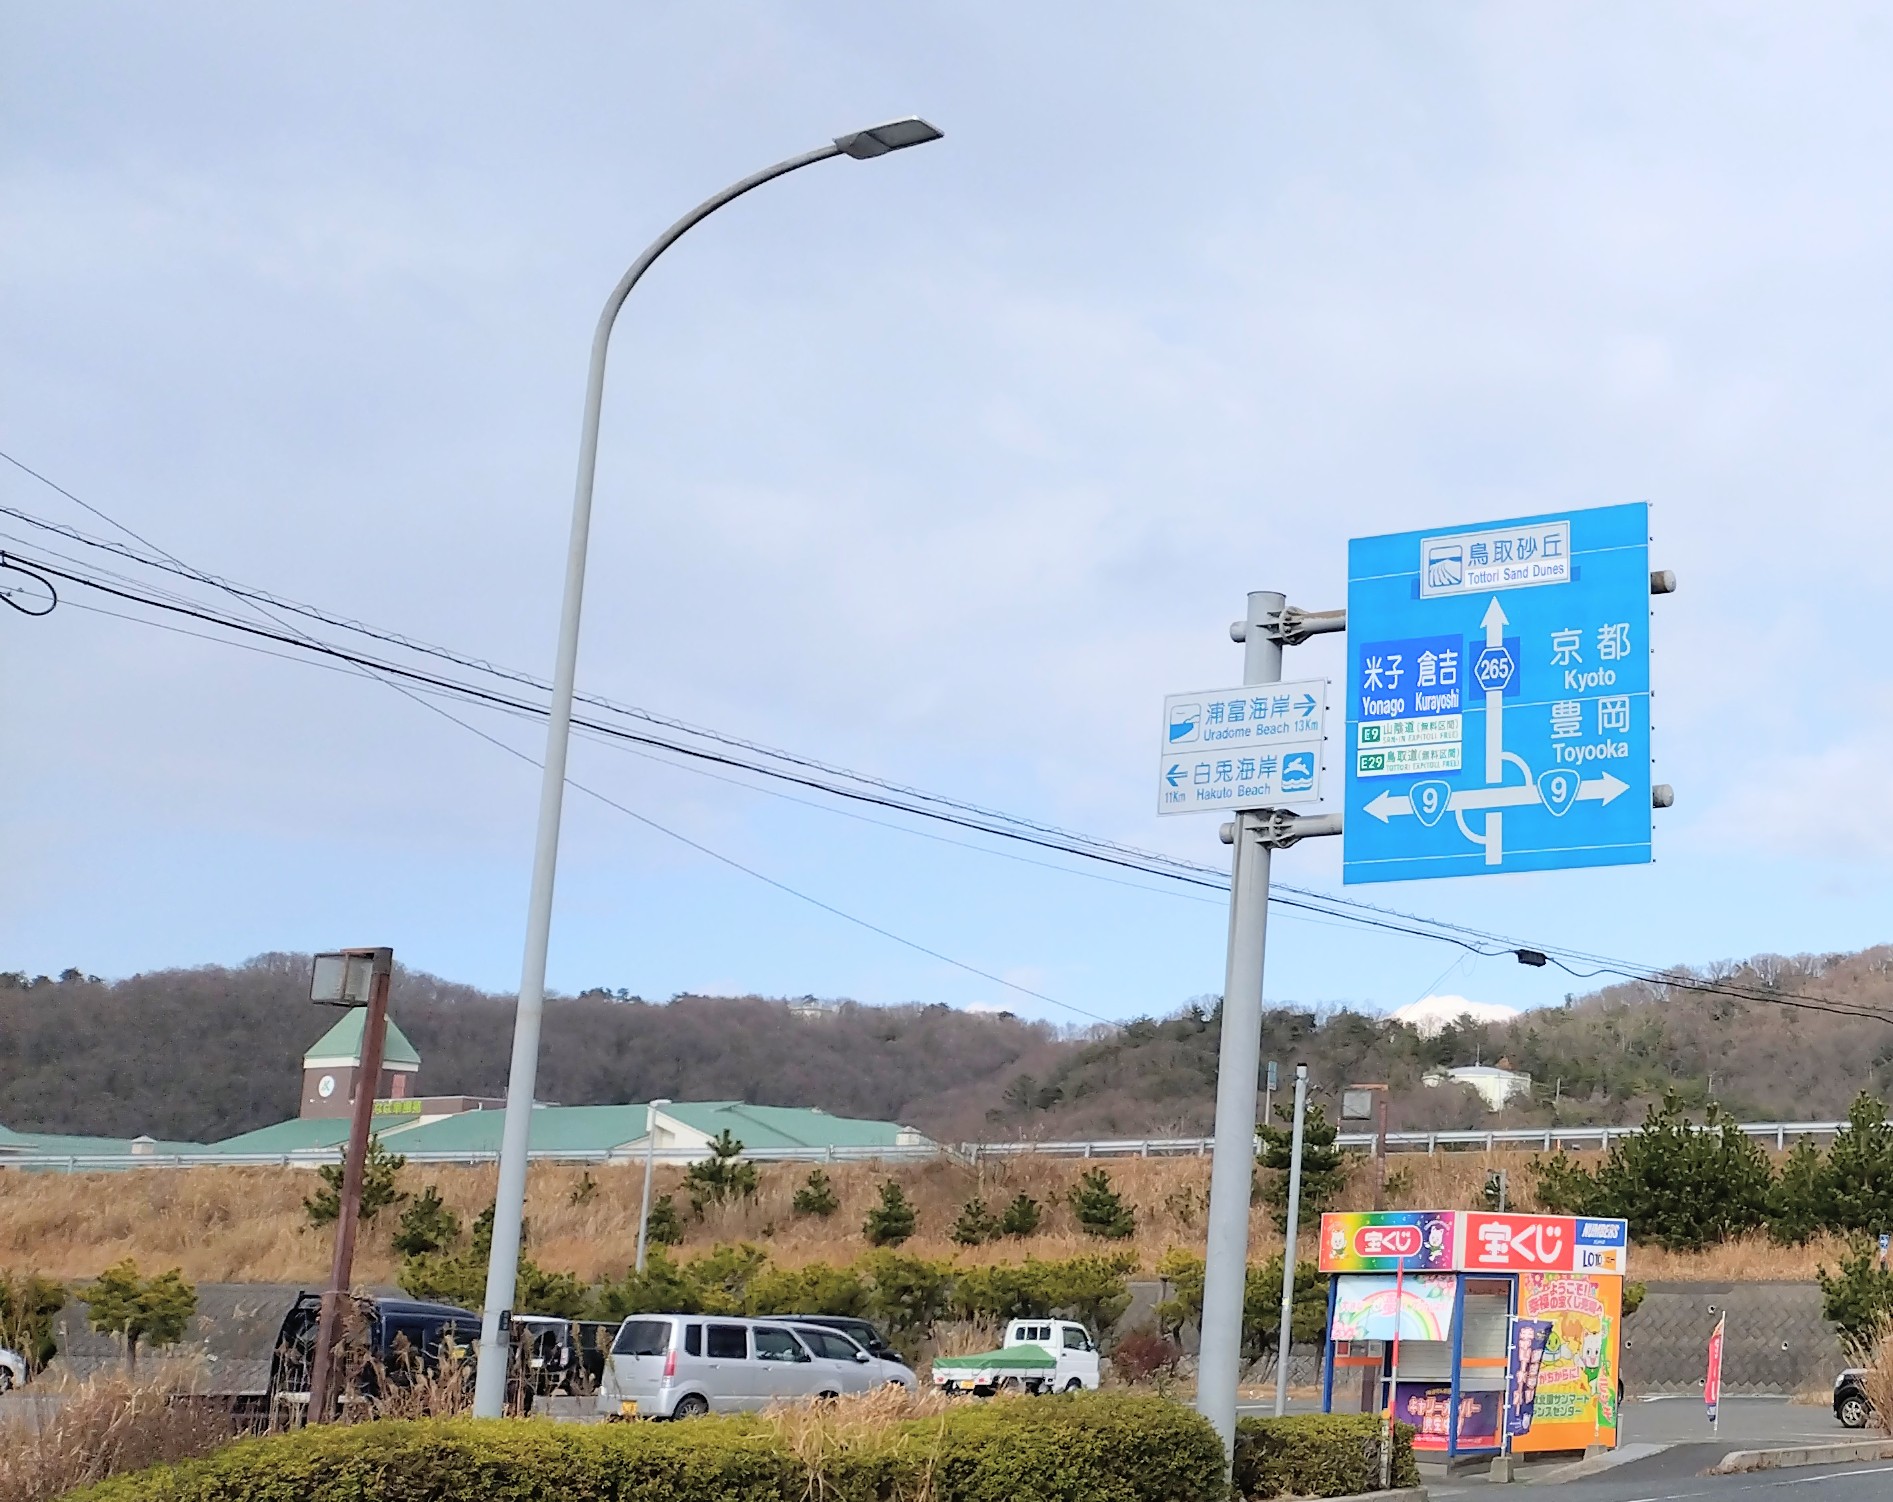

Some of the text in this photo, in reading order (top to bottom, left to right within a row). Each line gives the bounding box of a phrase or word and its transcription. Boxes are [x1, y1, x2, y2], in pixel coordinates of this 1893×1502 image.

[1467, 533, 1563, 567] 鳥取砂丘
[1467, 564, 1564, 585] Tottori Sand Dunes
[1550, 622, 1631, 666] 京都
[1363, 648, 1459, 691] 米子 倉吉
[1480, 657, 1508, 681] 265
[1564, 667, 1616, 693] Kyoto
[1205, 694, 1290, 725] 浦富海岸
[1362, 688, 1459, 716] Yonago Kurayoshi
[1203, 719, 1319, 741] Uradome Beach 13Km
[1550, 695, 1631, 740] 豊岡
[1364, 728, 1379, 741] E9
[1361, 756, 1383, 770] E29
[1552, 740, 1629, 765] Toyooka
[1193, 755, 1278, 785] 白兎海岸
[1196, 787, 1233, 801] Hakuto
[1237, 783, 1271, 797] Beach
[1550, 776, 1567, 799] 9
[1421, 791, 1438, 814] 9
[1364, 1230, 1411, 1253] 宝くじ
[1478, 1221, 1562, 1265] 宝くじ
